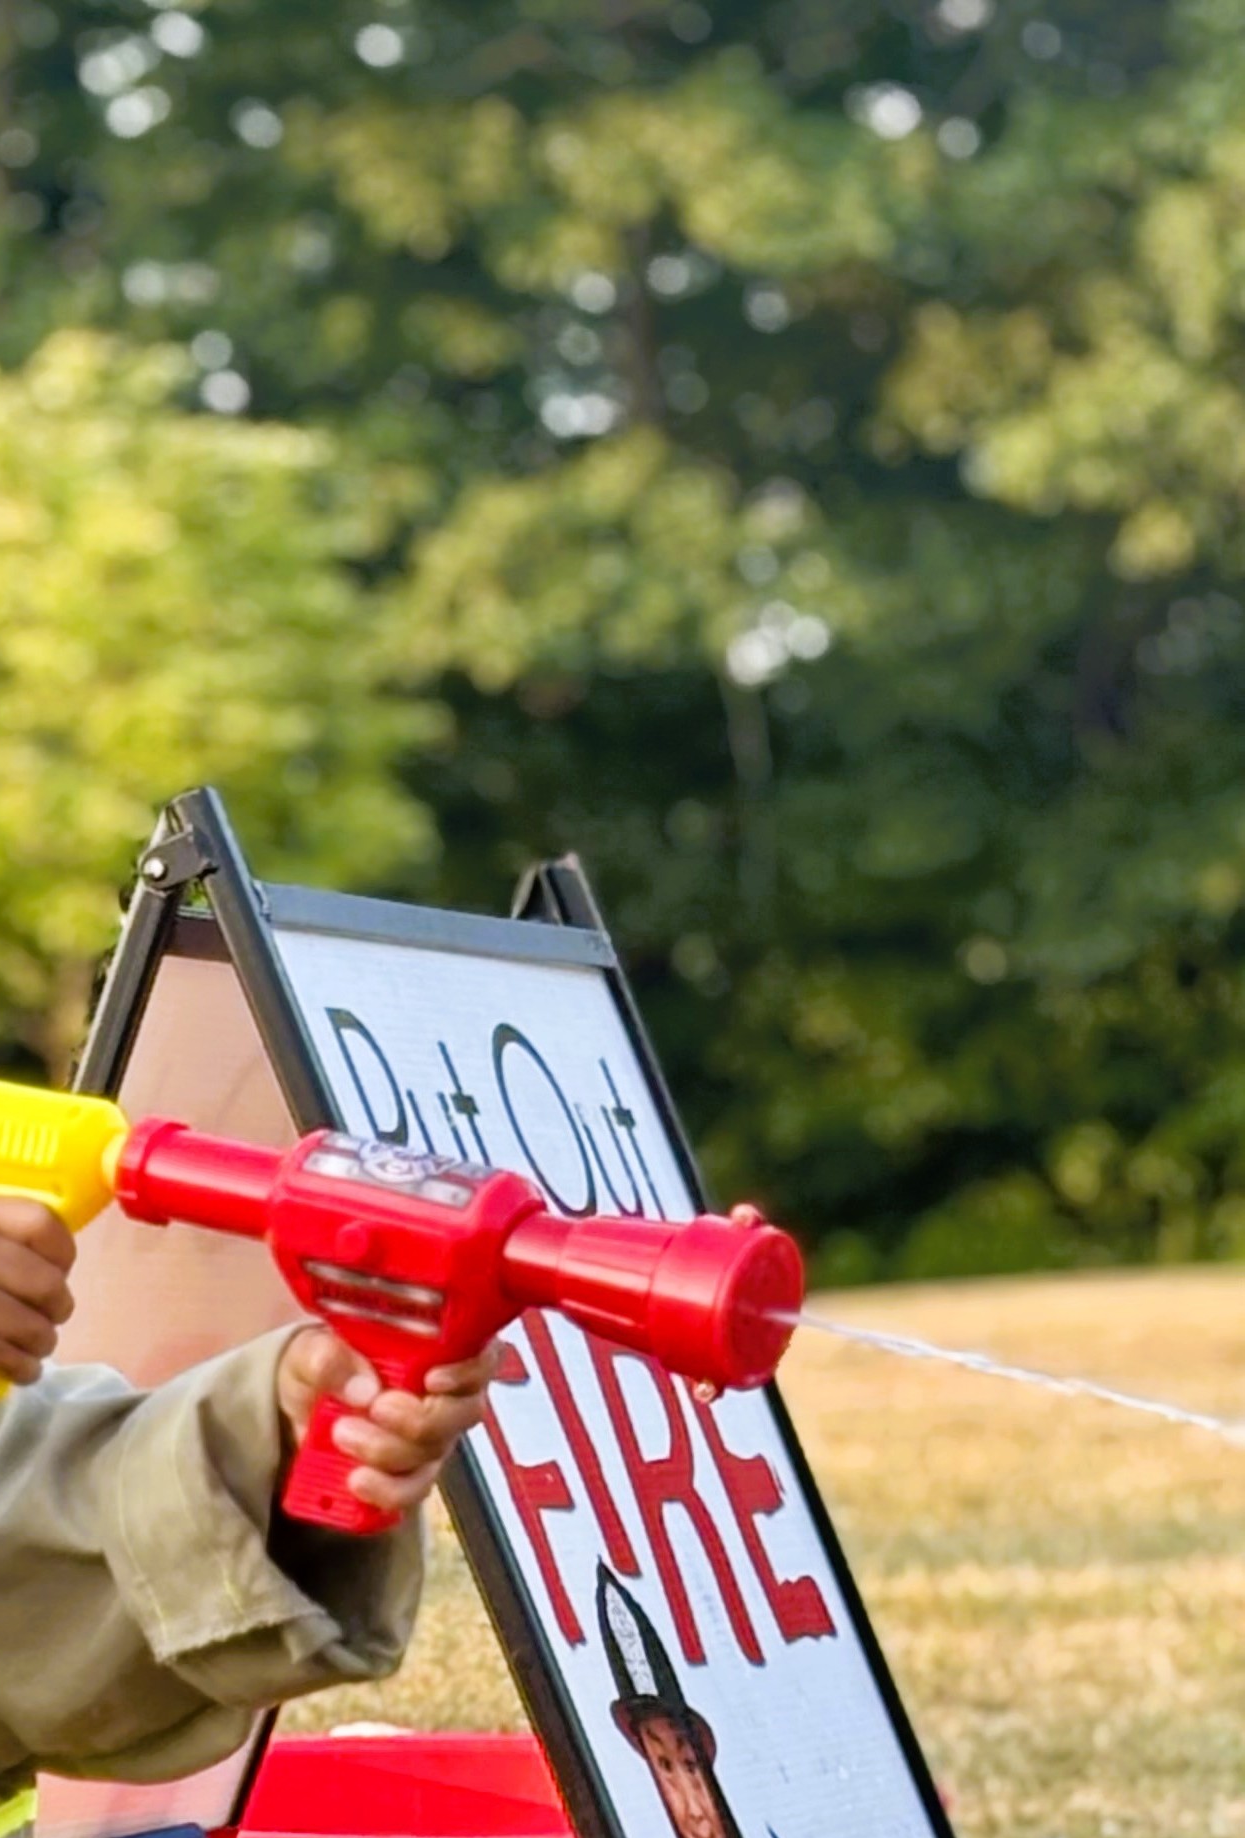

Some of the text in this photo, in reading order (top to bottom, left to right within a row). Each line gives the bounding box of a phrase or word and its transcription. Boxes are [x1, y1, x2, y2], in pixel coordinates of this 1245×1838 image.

[323, 1006, 667, 1222] Put Out
[481, 1307, 838, 1667] FIRE
